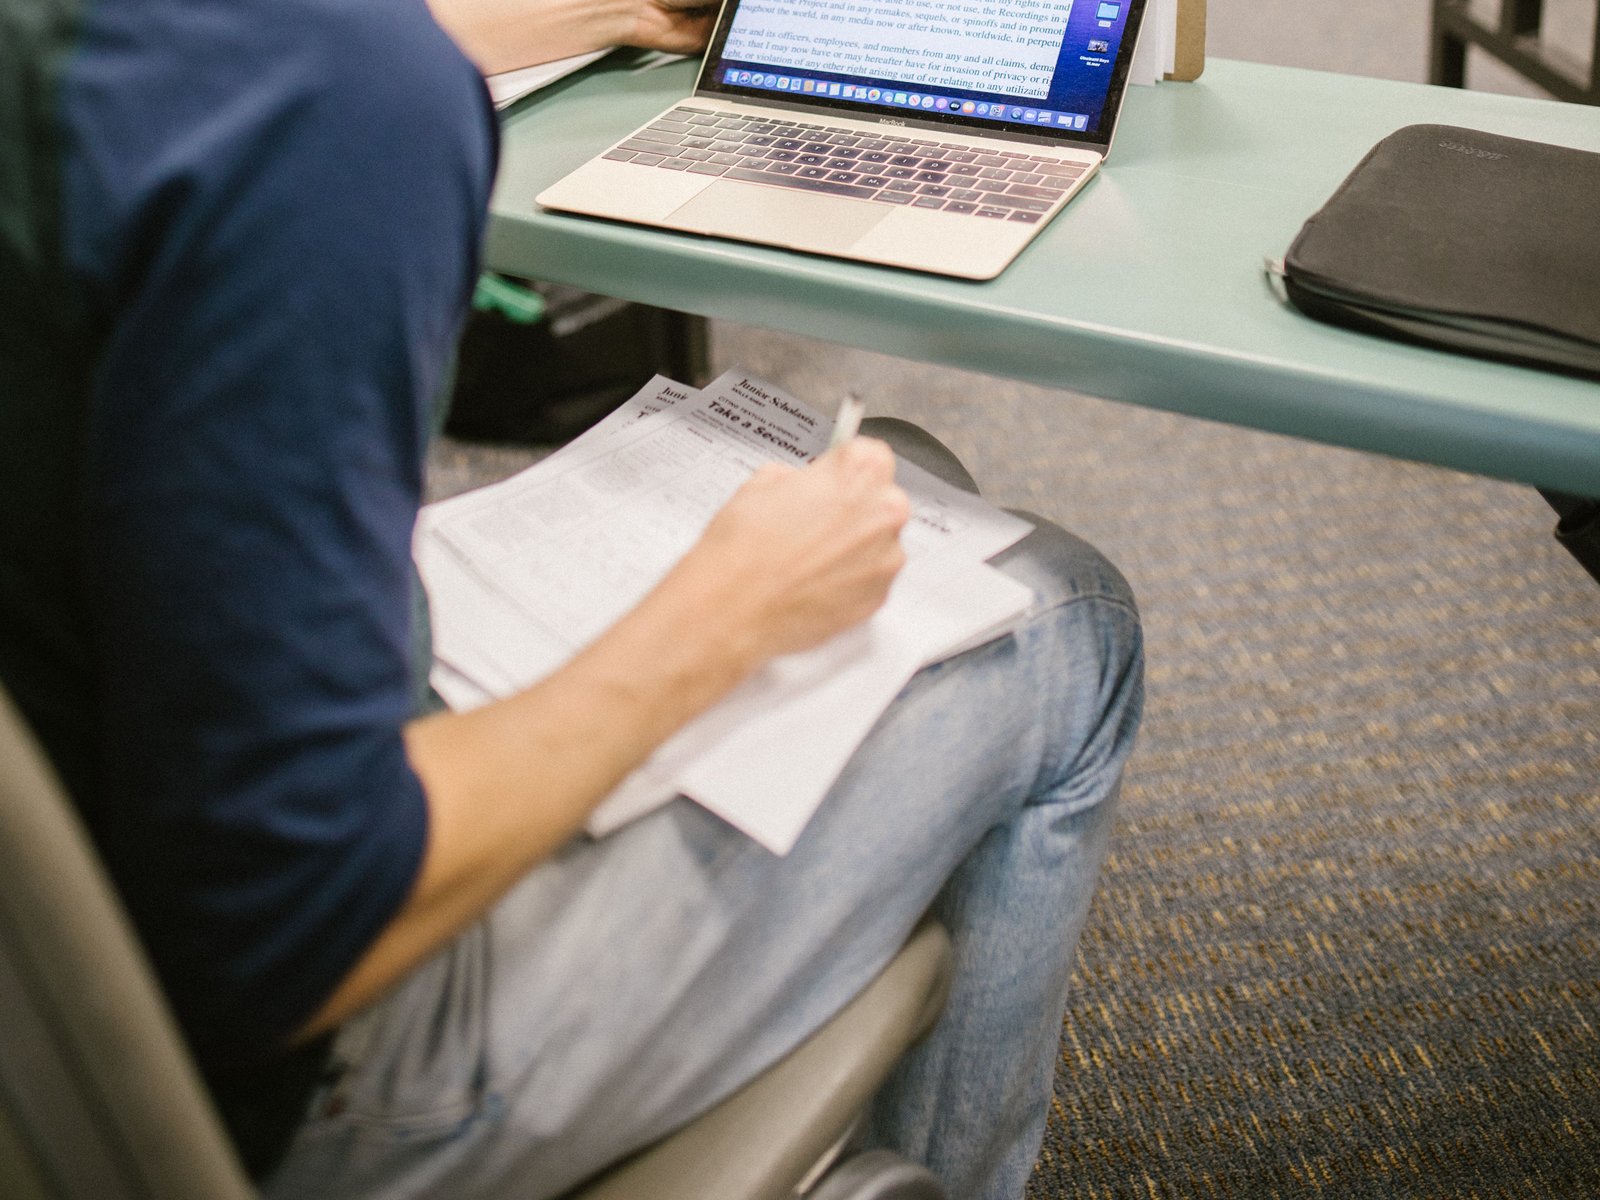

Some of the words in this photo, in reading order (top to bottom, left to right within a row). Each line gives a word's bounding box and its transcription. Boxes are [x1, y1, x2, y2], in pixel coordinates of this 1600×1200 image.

[982, 6, 997, 15] the
[998, 8, 1049, 23] Recordings
[1050, 14, 1061, 22] in
[1042, 0, 1052, 9] in
[1053, 2, 1072, 11] and
[848, 16, 875, 25] media
[876, 20, 896, 28] now
[907, 22, 929, 32] after
[930, 24, 962, 37] known,
[964, 30, 1014, 44] worldwide,
[1016, 34, 1026, 43] in
[962, 17, 999, 28] spinoffs
[1000, 21, 1018, 30] and
[1018, 22, 1028, 31] in
[810, 46, 832, 57] have
[844, 53, 864, 63] may
[864, 53, 904, 66] hereafter
[904, 58, 926, 69] have
[927, 61, 942, 70] for
[942, 63, 981, 75] invasion
[982, 68, 994, 77] of
[993, 70, 1028, 84] privacy
[862, 42, 880, 50] and
[880, 45, 921, 56] members
[922, 48, 944, 58] from
[945, 53, 962, 63] any
[963, 54, 982, 63] and
[982, 56, 995, 64] all
[995, 57, 1027, 70] claims,
[804, 60, 822, 70] any
[822, 61, 846, 71] other
[846, 64, 868, 75] right
[868, 67, 900, 80] arising
[900, 72, 916, 80] out
[916, 72, 928, 81] of
[939, 76, 975, 90] relating
[975, 81, 986, 89] to
[986, 83, 1004, 93] any
[880, 118, 905, 127] MacBook
[735, 378, 770, 400] Junior
[708, 400, 740, 422] Take
[741, 421, 752, 429] a
[753, 426, 809, 459] Second
